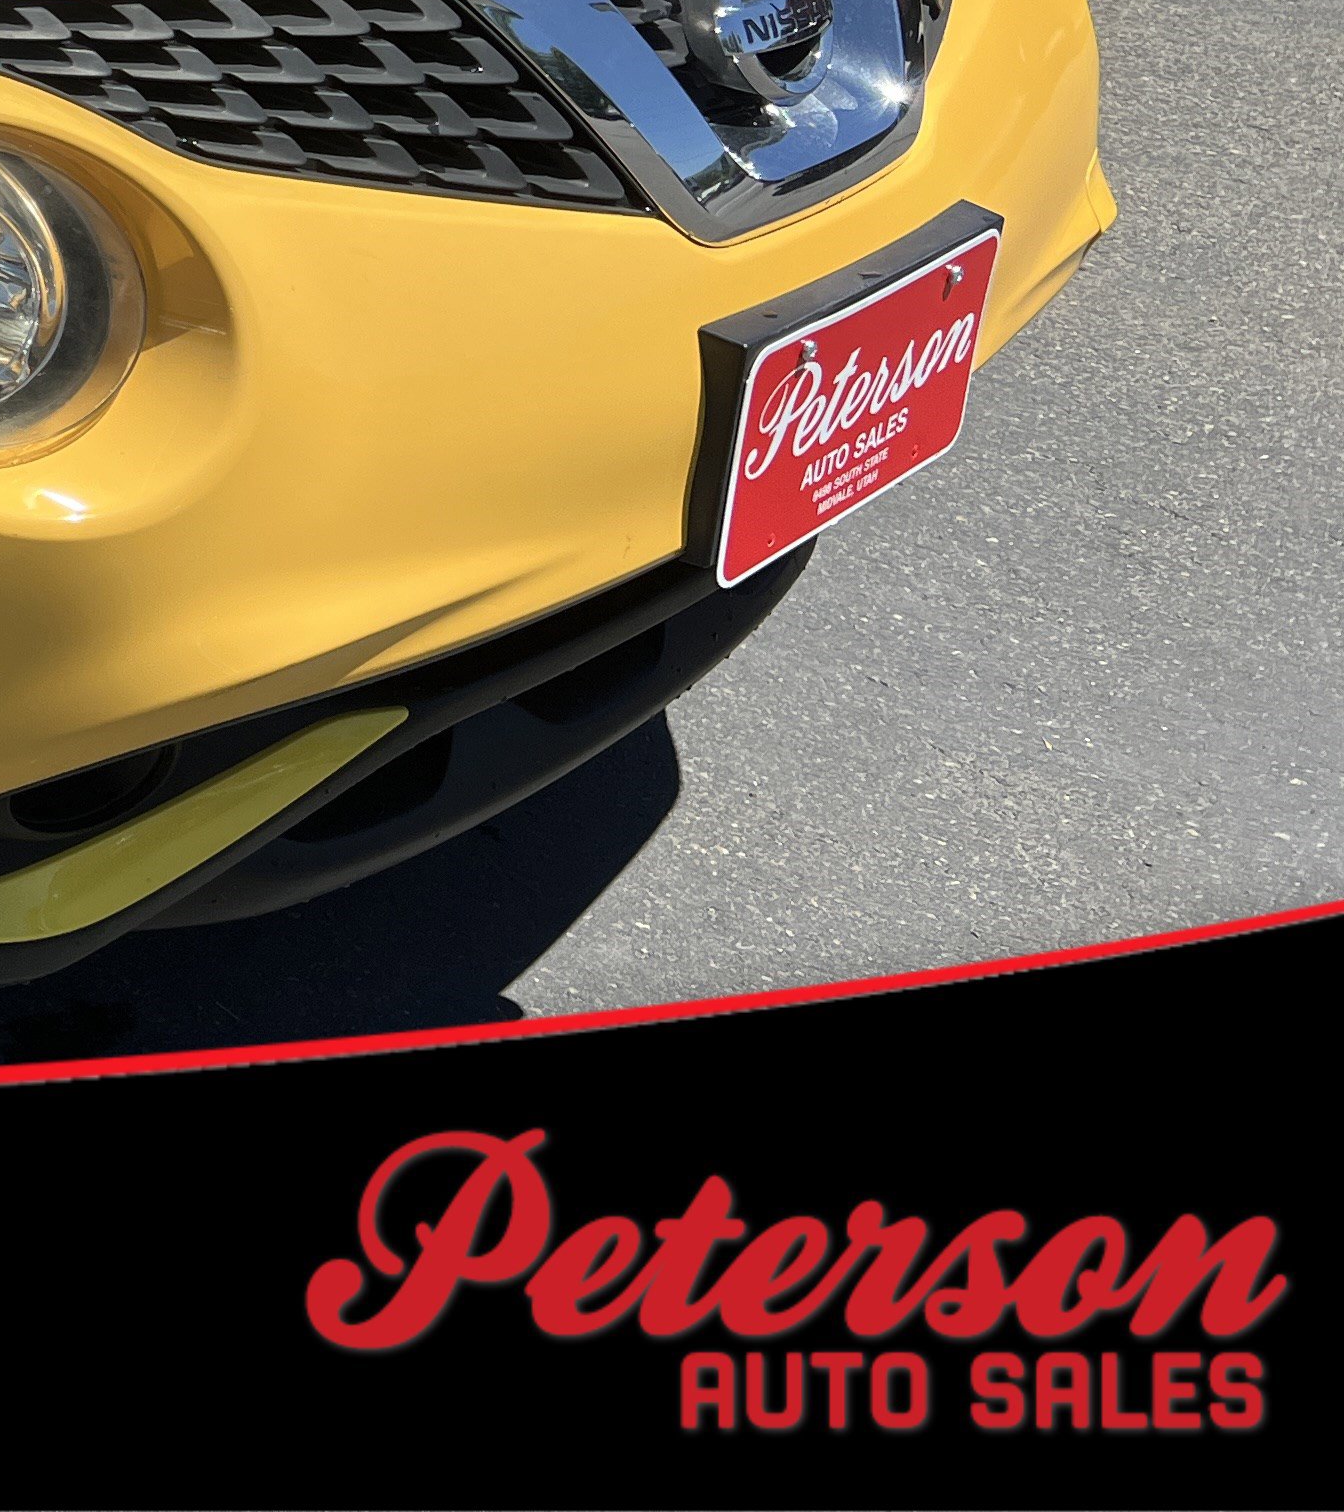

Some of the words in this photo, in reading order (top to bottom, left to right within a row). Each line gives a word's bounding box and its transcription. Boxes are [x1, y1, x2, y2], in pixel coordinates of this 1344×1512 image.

[745, 312, 974, 481] Peterson
[800, 443, 850, 491] AUTO
[853, 408, 909, 459] SALES
[833, 464, 863, 490] SOUTH
[864, 447, 889, 471] STATE
[857, 469, 879, 491] UTAH
